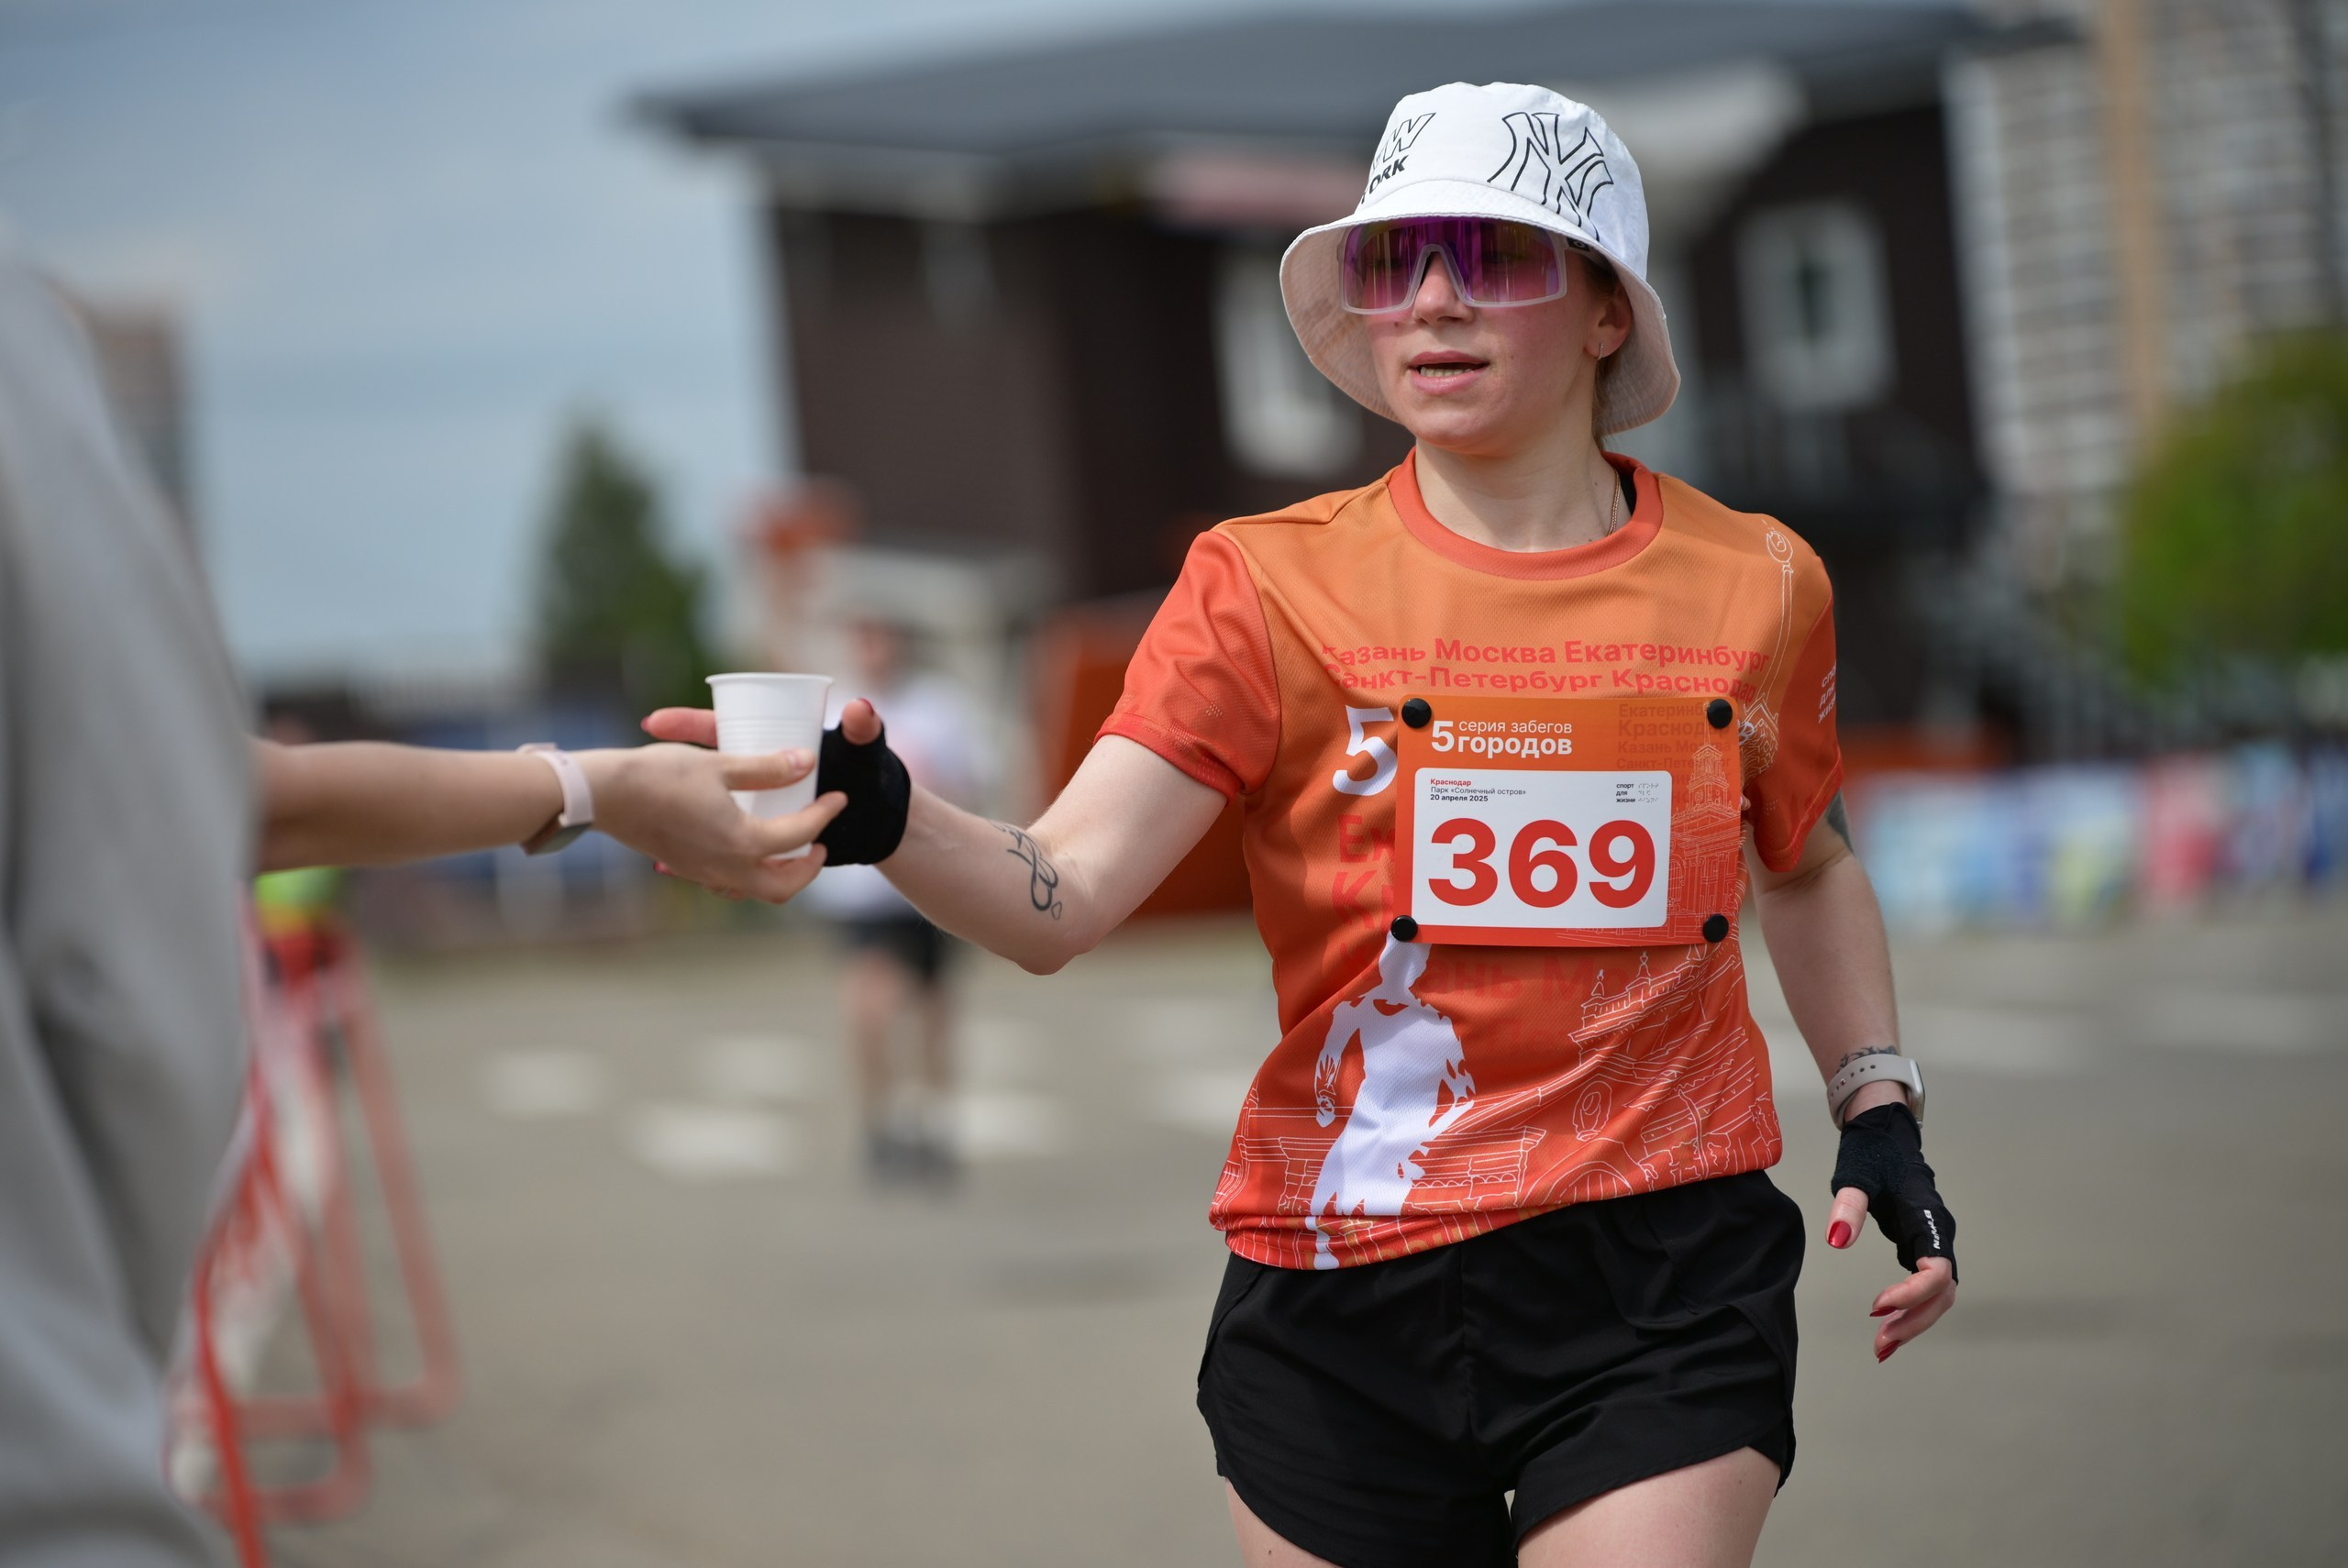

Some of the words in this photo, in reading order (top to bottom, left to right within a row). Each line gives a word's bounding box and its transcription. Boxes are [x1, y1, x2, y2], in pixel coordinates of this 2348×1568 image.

[1434, 637, 1556, 664] Москва
[1565, 640, 1770, 675] Екатеринбург
[1611, 668, 1757, 702] Краснодар
[1431, 720, 1455, 753] 5
[1457, 735, 1573, 759] городов
[1458, 720, 1506, 734] серия
[1511, 720, 1573, 734] забегов
[1333, 704, 1397, 796] 5
[1617, 740, 1672, 754] Казань
[1430, 778, 1472, 787] Краснодар
[1431, 786, 1449, 794] Парк
[1451, 787, 1496, 795] «Солнечный
[1428, 816, 1656, 909] 369
